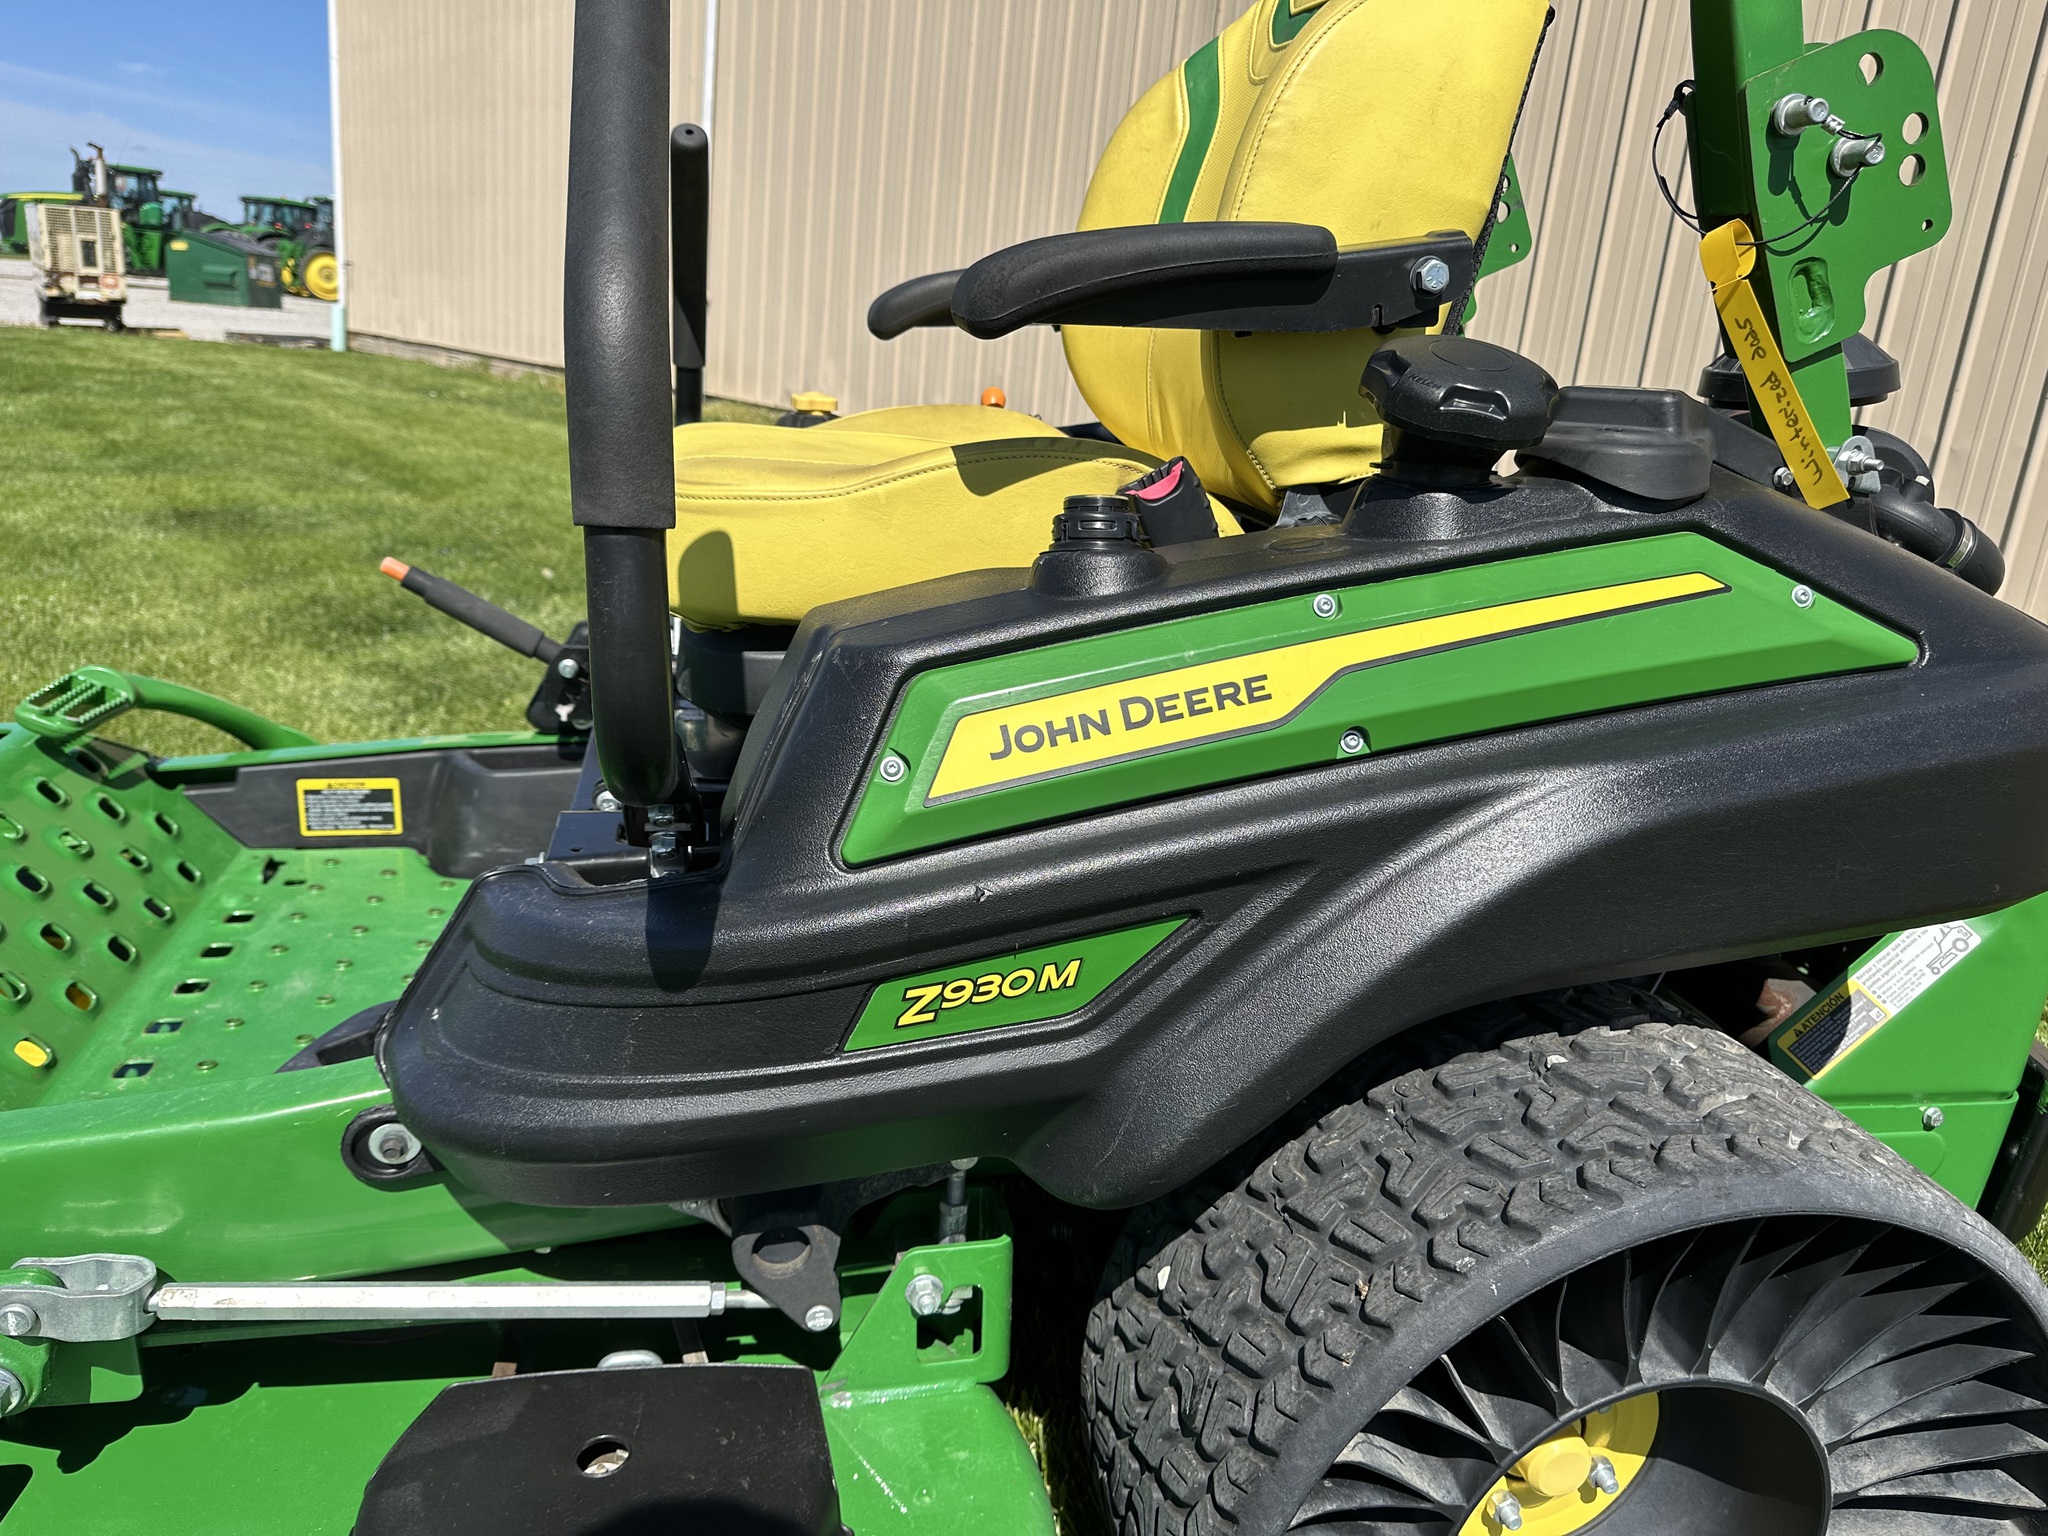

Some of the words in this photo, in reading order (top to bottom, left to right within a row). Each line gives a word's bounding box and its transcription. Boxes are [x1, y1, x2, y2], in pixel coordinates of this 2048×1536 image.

[1759, 370, 1823, 485] Winterized
[989, 709, 1111, 761] JOHN
[1118, 674, 1272, 732] DEERE
[894, 957, 1084, 1029] Z930M
[1800, 991, 1844, 1031] ATENCIÓN
